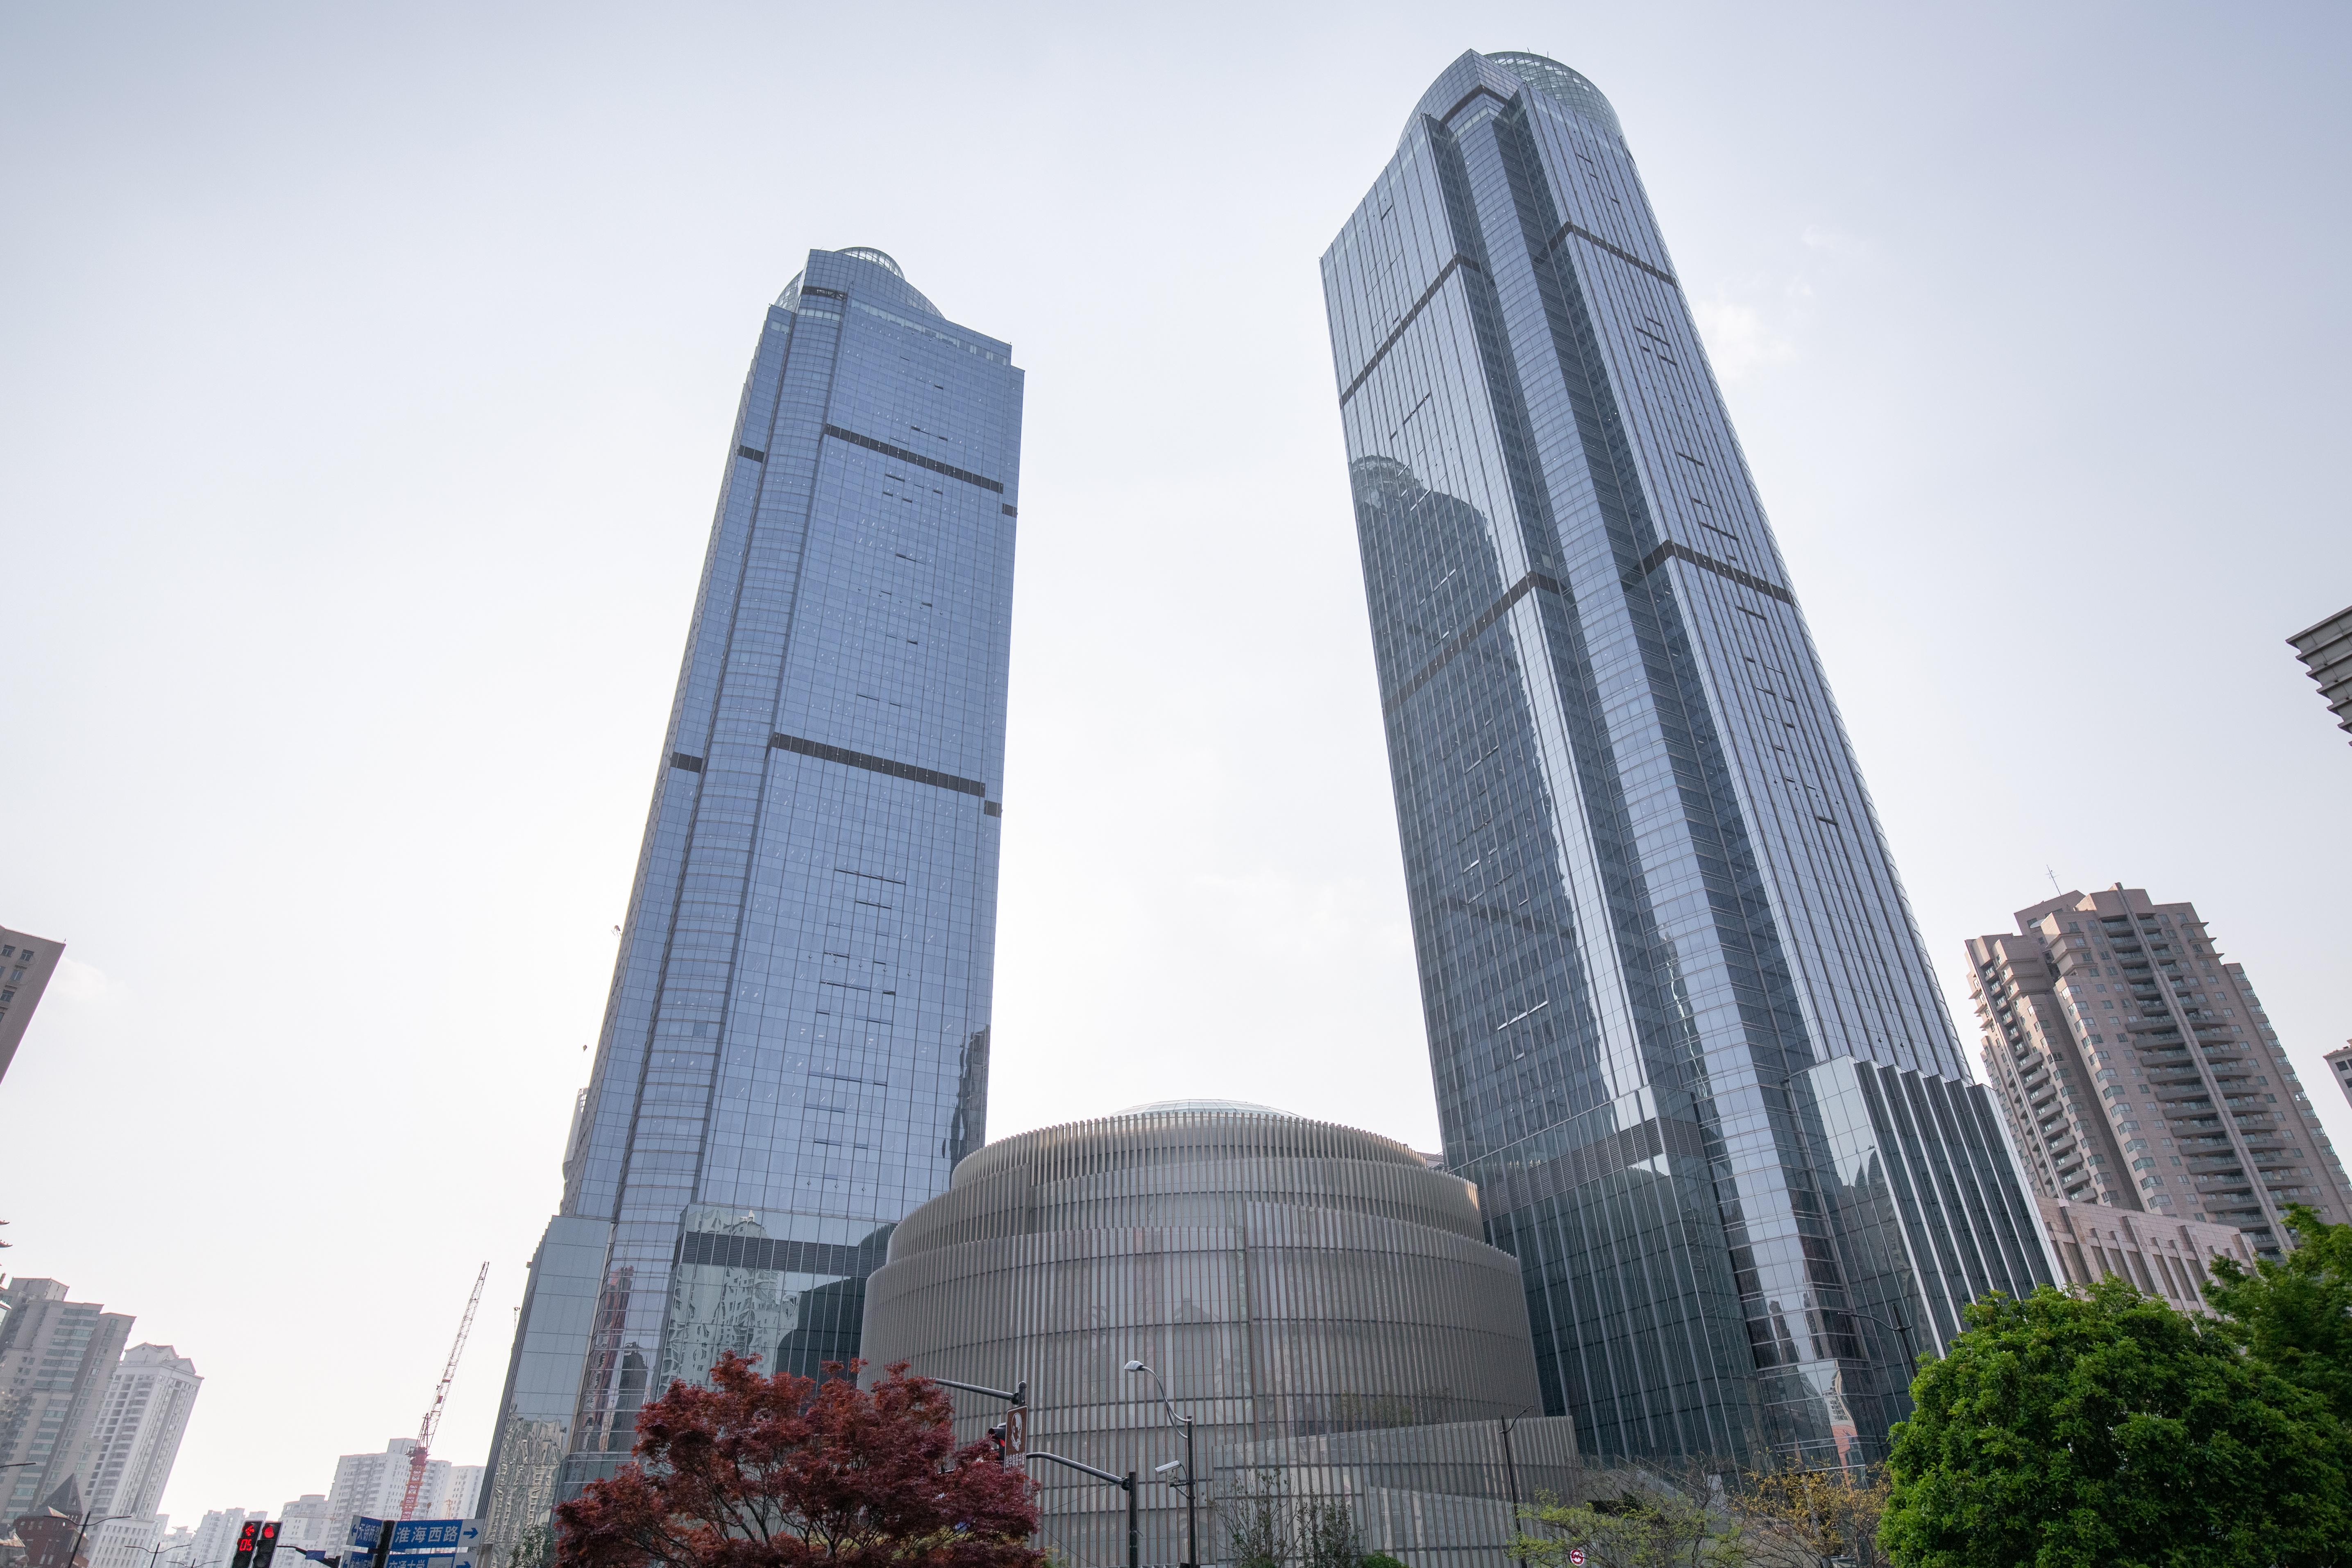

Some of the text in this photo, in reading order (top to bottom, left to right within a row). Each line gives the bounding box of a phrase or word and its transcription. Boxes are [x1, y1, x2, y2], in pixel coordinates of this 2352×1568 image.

[1006, 1451, 1025, 1468] 钱学森图书馆
[357, 1523, 381, 1542] 天钥桥路
[395, 1525, 458, 1543] 淮海西路
[239, 1539, 252, 1551] 05
